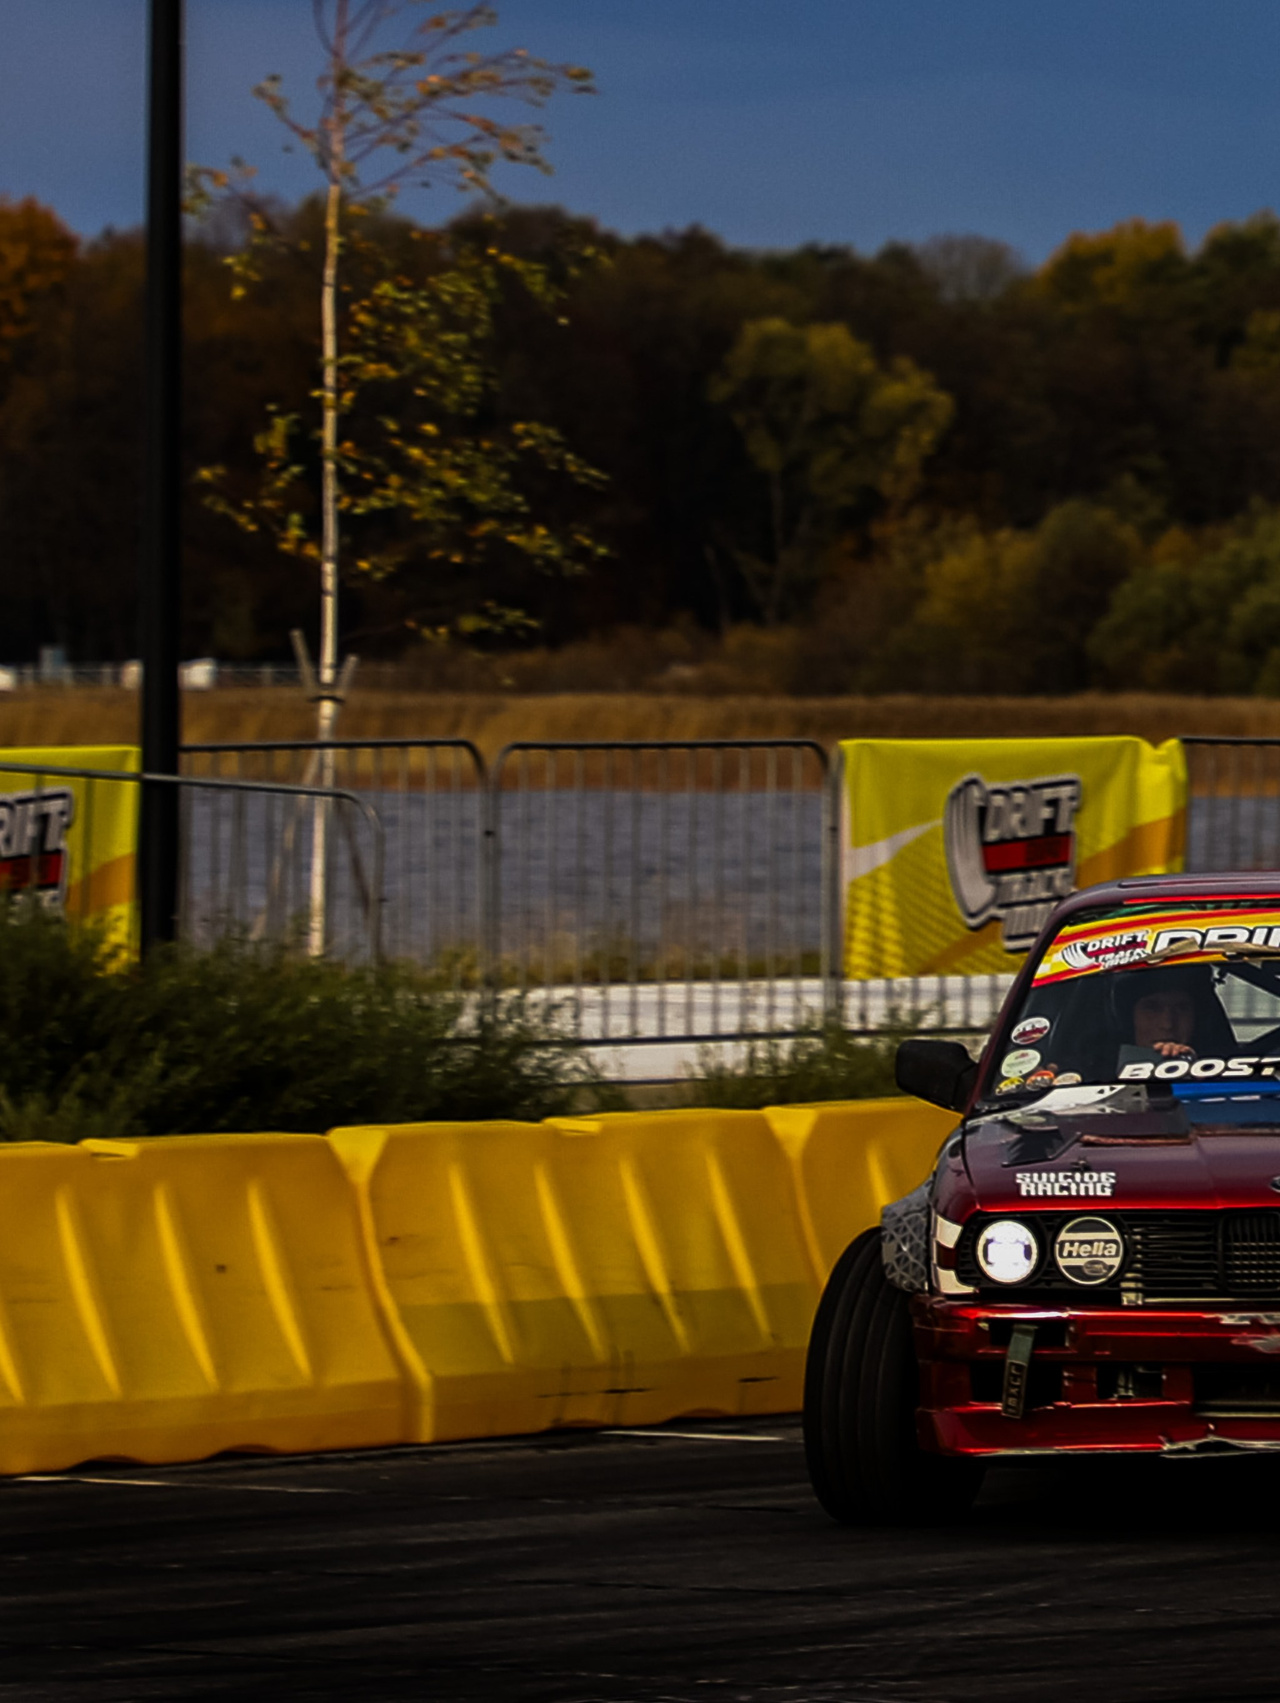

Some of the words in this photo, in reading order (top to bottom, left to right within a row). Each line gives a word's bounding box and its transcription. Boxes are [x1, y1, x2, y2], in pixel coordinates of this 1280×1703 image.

[1087, 930, 1148, 952] DRIFT
[1015, 1172, 1117, 1183] SUICIDE
[1020, 1182, 1113, 1197] RACING
[1061, 1241, 1118, 1258] Hella
